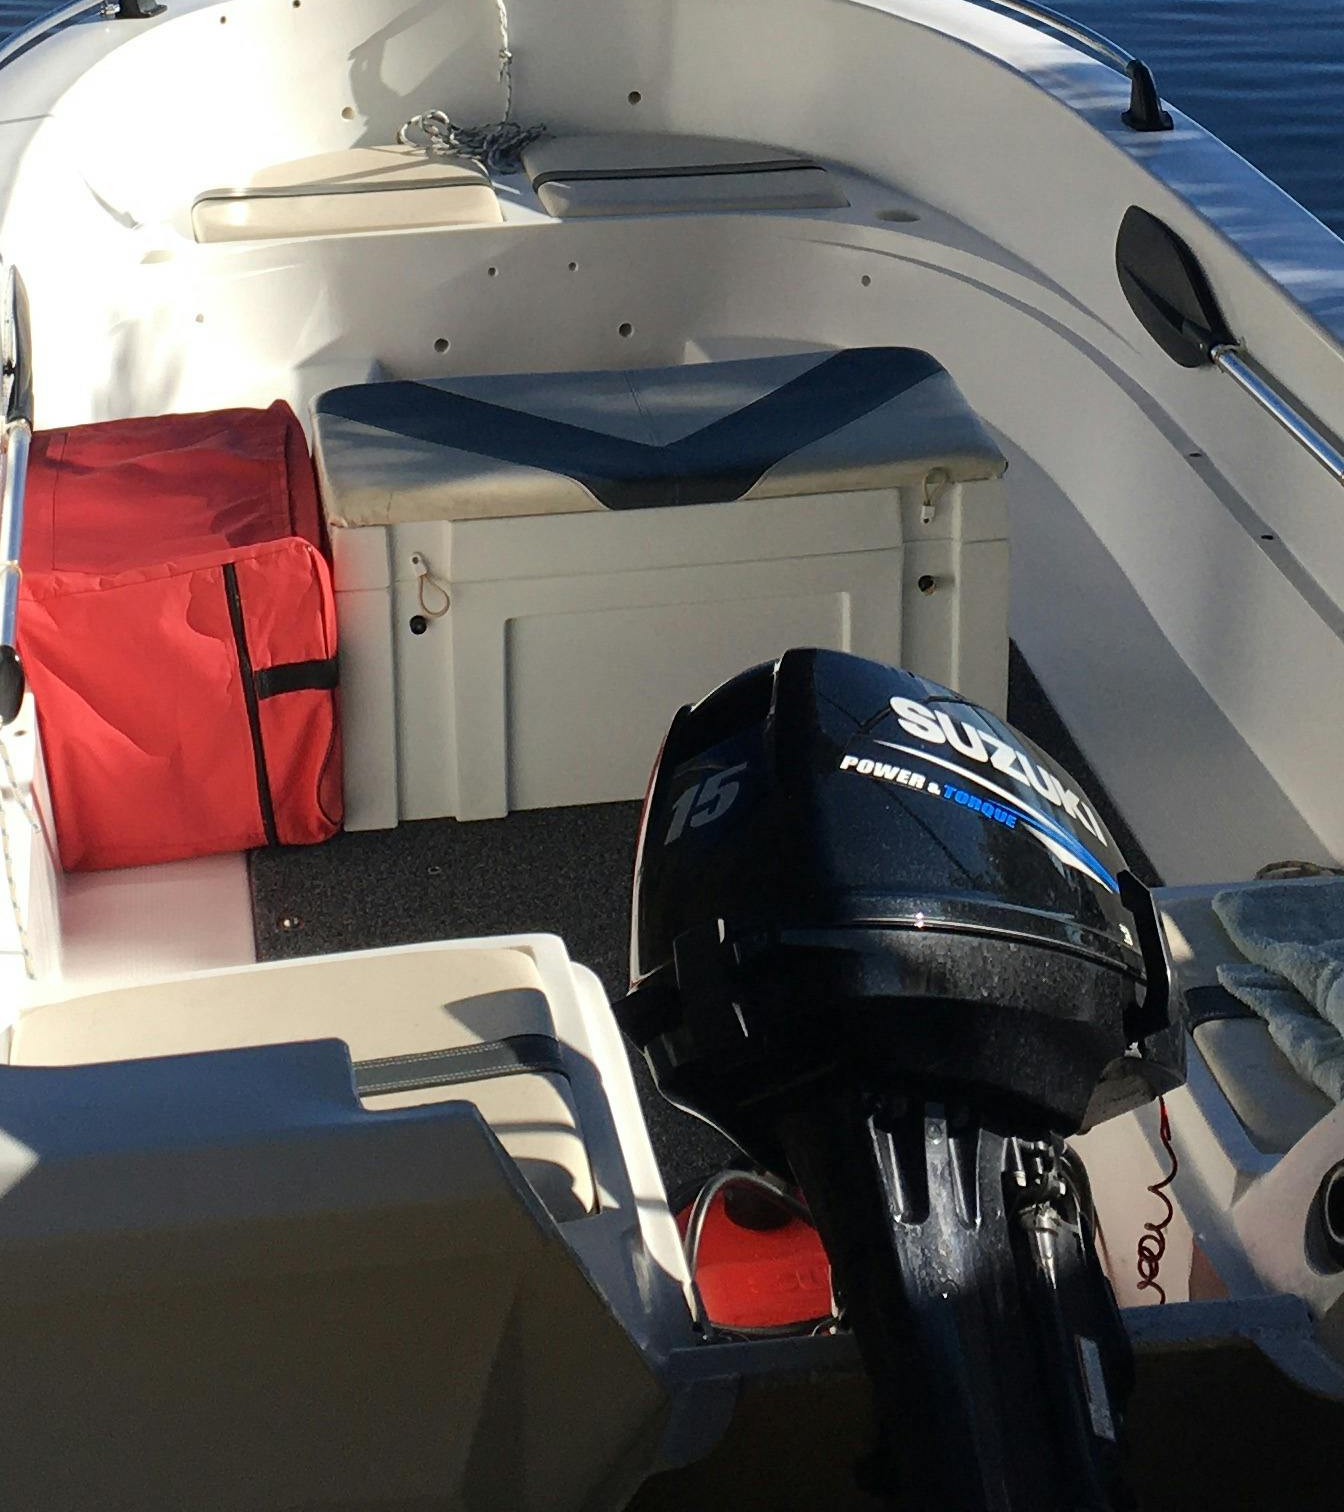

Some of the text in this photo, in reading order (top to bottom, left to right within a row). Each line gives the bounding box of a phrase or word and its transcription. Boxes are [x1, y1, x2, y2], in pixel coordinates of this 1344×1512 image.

[664, 761, 748, 845] 15
[840, 754, 1018, 829] POWER & TORQUE
[889, 696, 1108, 847] SUZUKI
